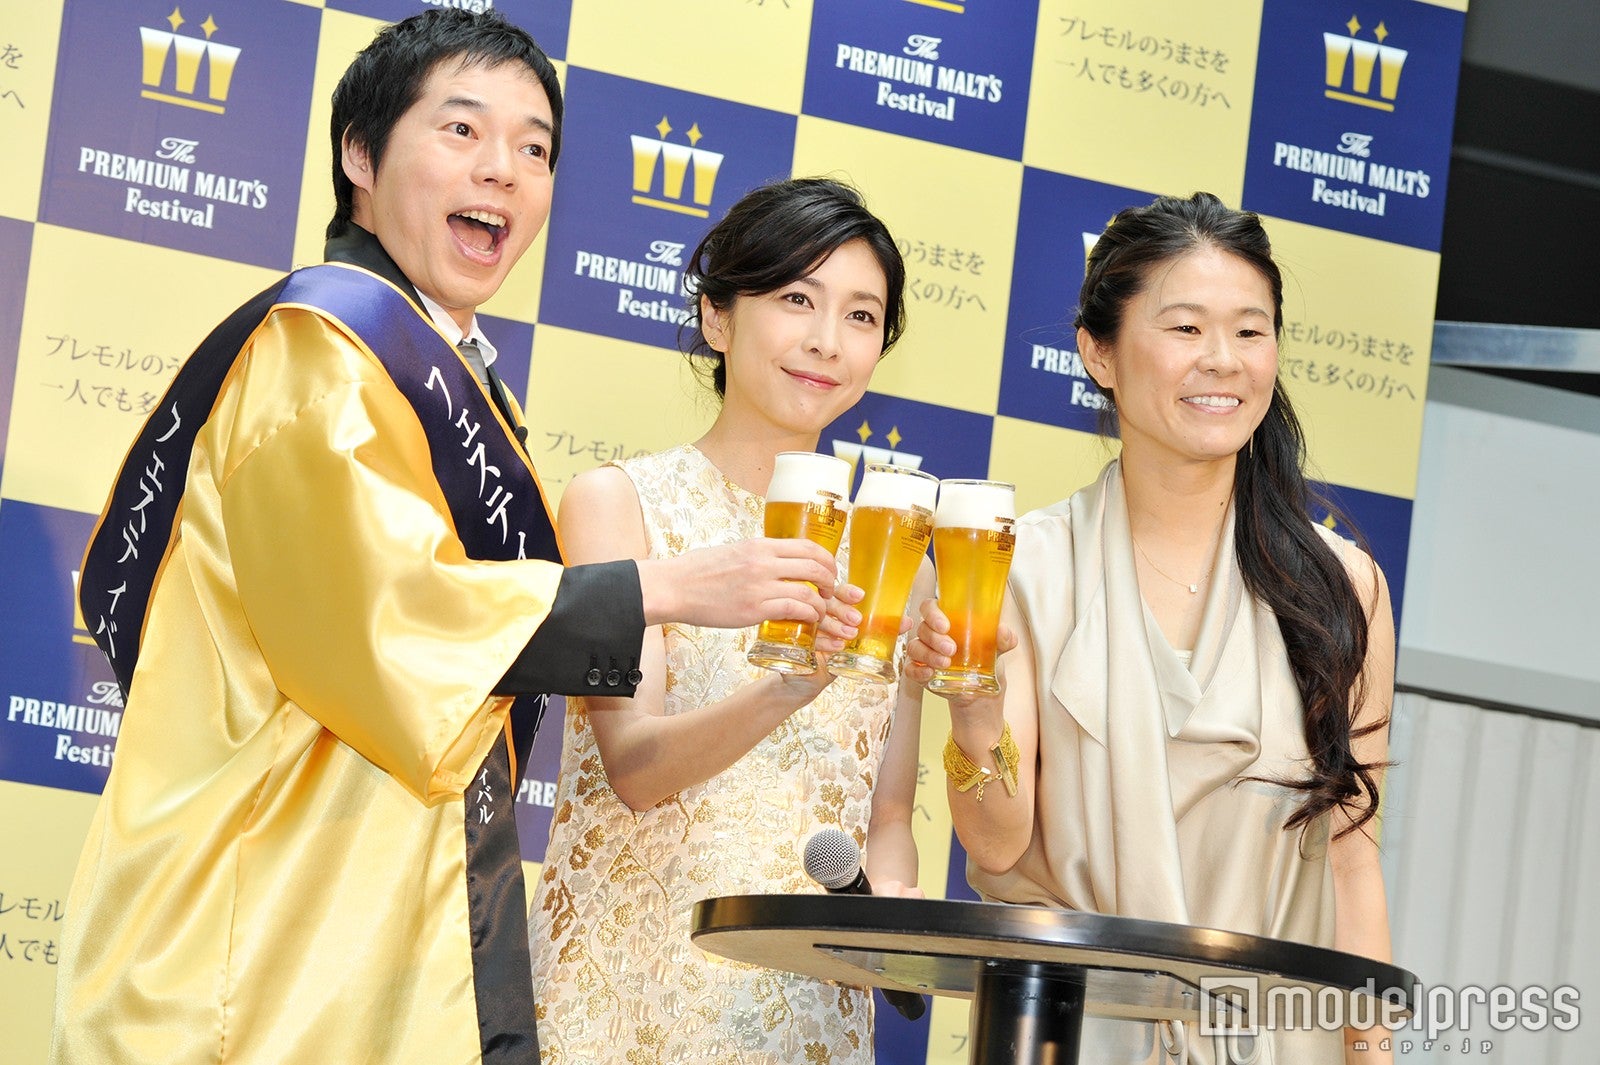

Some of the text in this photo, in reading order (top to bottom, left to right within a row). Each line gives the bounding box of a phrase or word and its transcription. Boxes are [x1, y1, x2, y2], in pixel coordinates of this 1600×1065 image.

[902, 34, 942, 60] The
[835, 44, 1003, 103] PREMIUM MALT'S
[1055, 57, 1231, 109] 一人でも多くの方へ
[876, 81, 955, 121] Festival
[156, 137, 199, 164] The
[1336, 132, 1374, 158] The
[78, 147, 269, 210] PREMIUM MALT'S
[1273, 142, 1431, 198] PREMIUM MALT'S
[125, 187, 214, 229] Festival
[1311, 178, 1386, 217] Festival
[574, 250, 678, 295] PREMIUM
[645, 240, 686, 267] The
